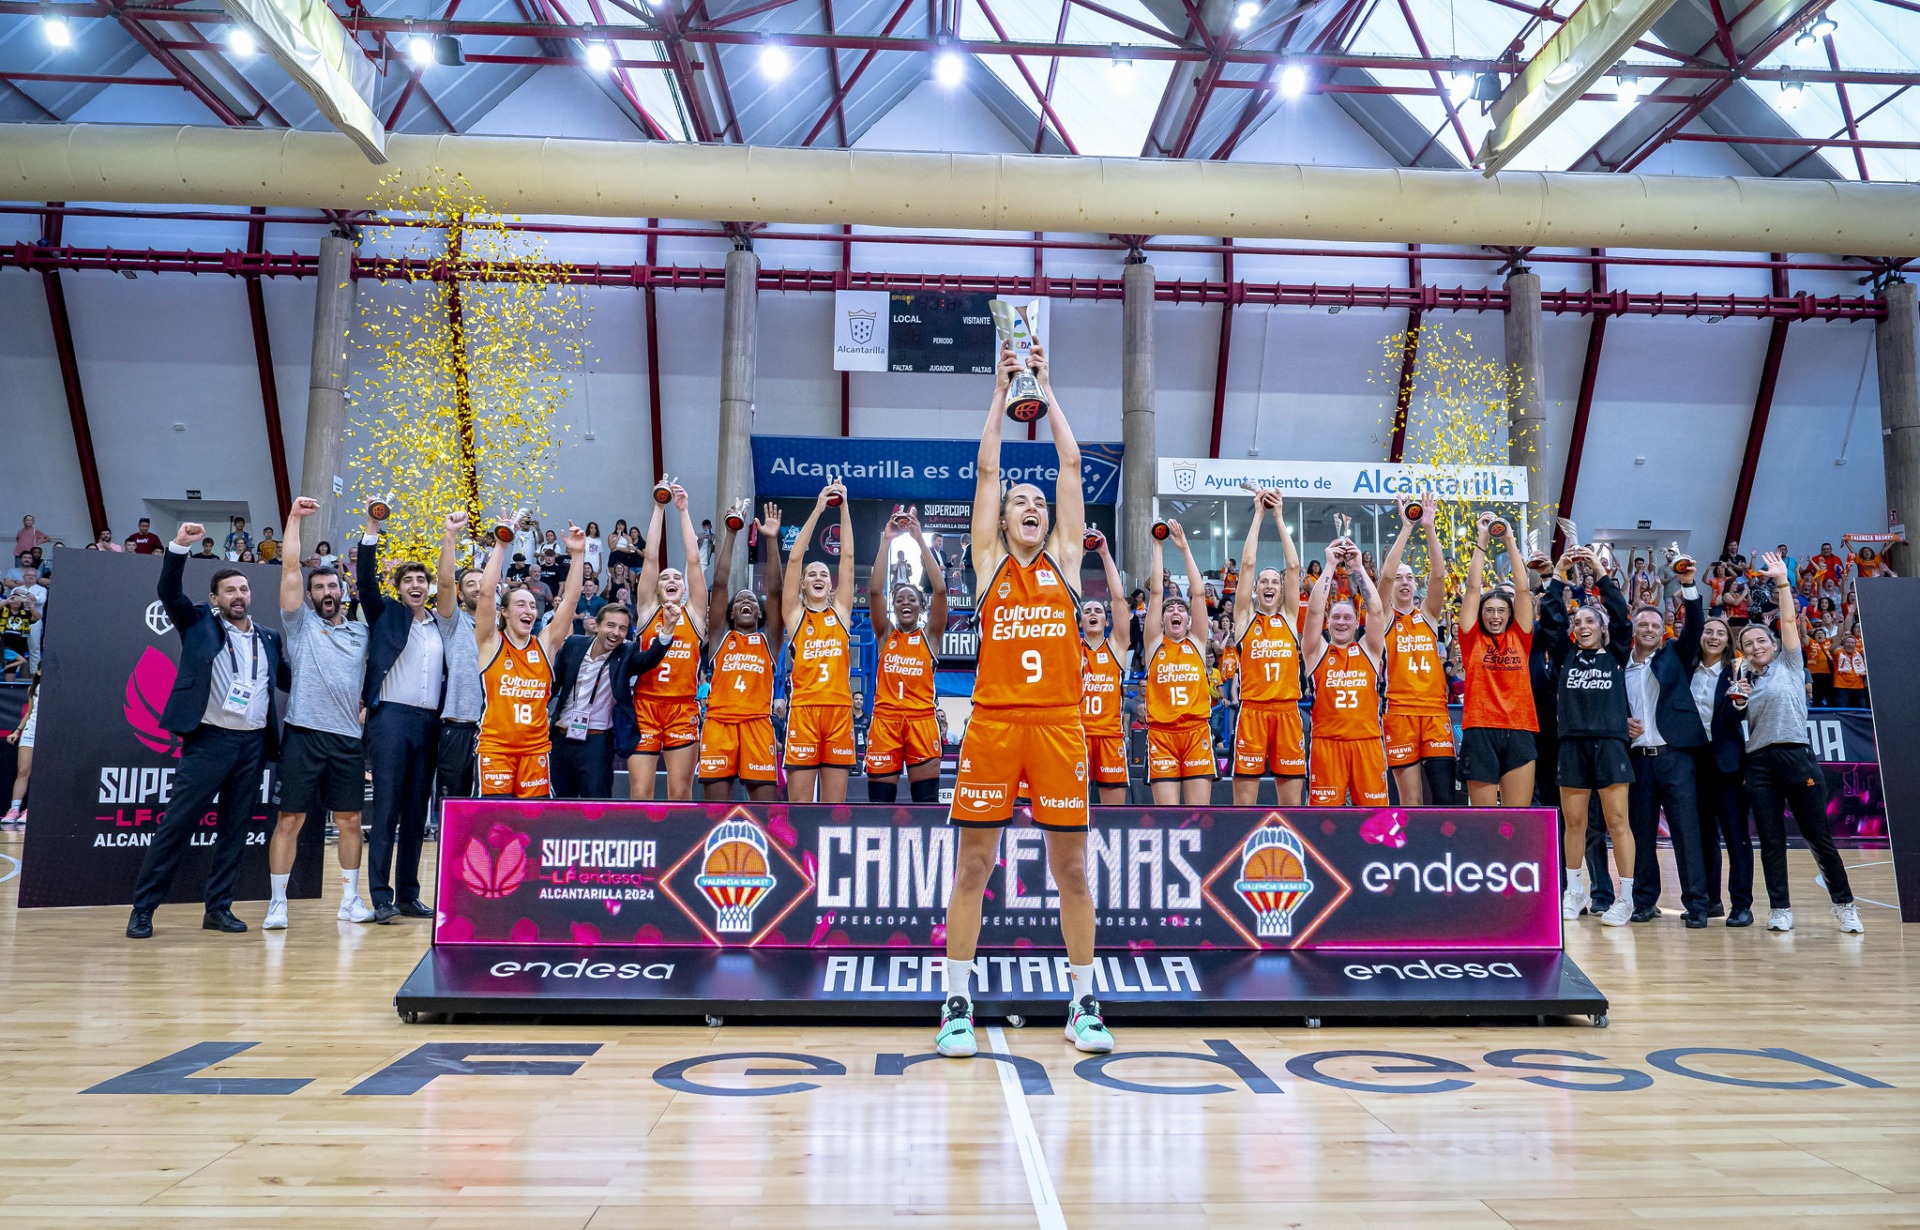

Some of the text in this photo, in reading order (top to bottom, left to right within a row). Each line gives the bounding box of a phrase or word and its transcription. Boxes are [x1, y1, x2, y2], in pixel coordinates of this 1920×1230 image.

[893, 314, 921, 324] LOCAL
[962, 317, 991, 325] VISITANTE
[837, 345, 885, 355] Alcantarilla
[892, 364, 913, 372] FALTAS
[971, 366, 992, 374] FALTAS
[771, 457, 1059, 481] Alcantarilla es dorte
[1204, 474, 1332, 490] Ayuntmiento de
[1353, 469, 1514, 496] Alcantarilla
[924, 504, 970, 517] SUPERCOPA
[993, 605, 1065, 623] Cultura del
[992, 621, 1067, 641] Esfuerzo
[804, 638, 836, 649] Cultura
[1250, 639, 1284, 649] Cultura
[663, 650, 691, 659] erzo
[723, 652, 758, 663] Cultura
[884, 653, 917, 666] Cultura
[1250, 648, 1293, 660] Esfuerzo
[721, 662, 765, 674] Esfuerzo
[883, 662, 923, 676] Esfuerzo
[1021, 649, 1043, 684] 9
[1157, 663, 1190, 673] Cultura
[1264, 662, 1281, 682] 17
[1407, 656, 1431, 674] 44
[657, 662, 671, 683] 2
[818, 663, 829, 683] 3
[1157, 672, 1200, 684] Esfuerzo
[500, 674, 539, 688] Cultura
[733, 675, 747, 693] 4
[1083, 682, 1115, 693] fuerzo
[1325, 678, 1368, 688] Esfuerzo
[499, 684, 546, 699] Esfuerzo
[897, 681, 904, 700] 1
[1169, 686, 1189, 706] 15
[1085, 696, 1102, 715] 10
[1335, 690, 1359, 709] 23
[513, 703, 533, 725] 18
[1388, 747, 1413, 755] PULEVA
[700, 758, 726, 766] PULEVA
[1152, 759, 1177, 767] PULEVA
[1184, 759, 1211, 768] Vitaldin
[1238, 755, 1263, 763] PULEVA
[960, 787, 1004, 800] PULEVA
[1311, 789, 1336, 797] PULEVA
[1039, 796, 1085, 809] Vitaldin
[115, 809, 152, 827] LF
[541, 838, 657, 868] SUPERCOPA
[815, 826, 1202, 910] CAMENAS
[1361, 852, 1540, 893] endesa
[551, 869, 642, 886] LF endesa
[702, 878, 769, 886] VALENCIA BASKET
[539, 887, 655, 901] ALCANTARILLA 2024
[816, 915, 918, 926] SUPERCOPA
[982, 916, 1058, 927] FEMENIN
[1095, 917, 1148, 927] NDESA
[1159, 916, 1202, 927] 2024
[490, 958, 677, 980] endesa
[1343, 959, 1524, 981] endesa
[652, 1039, 1897, 1097] endesa
